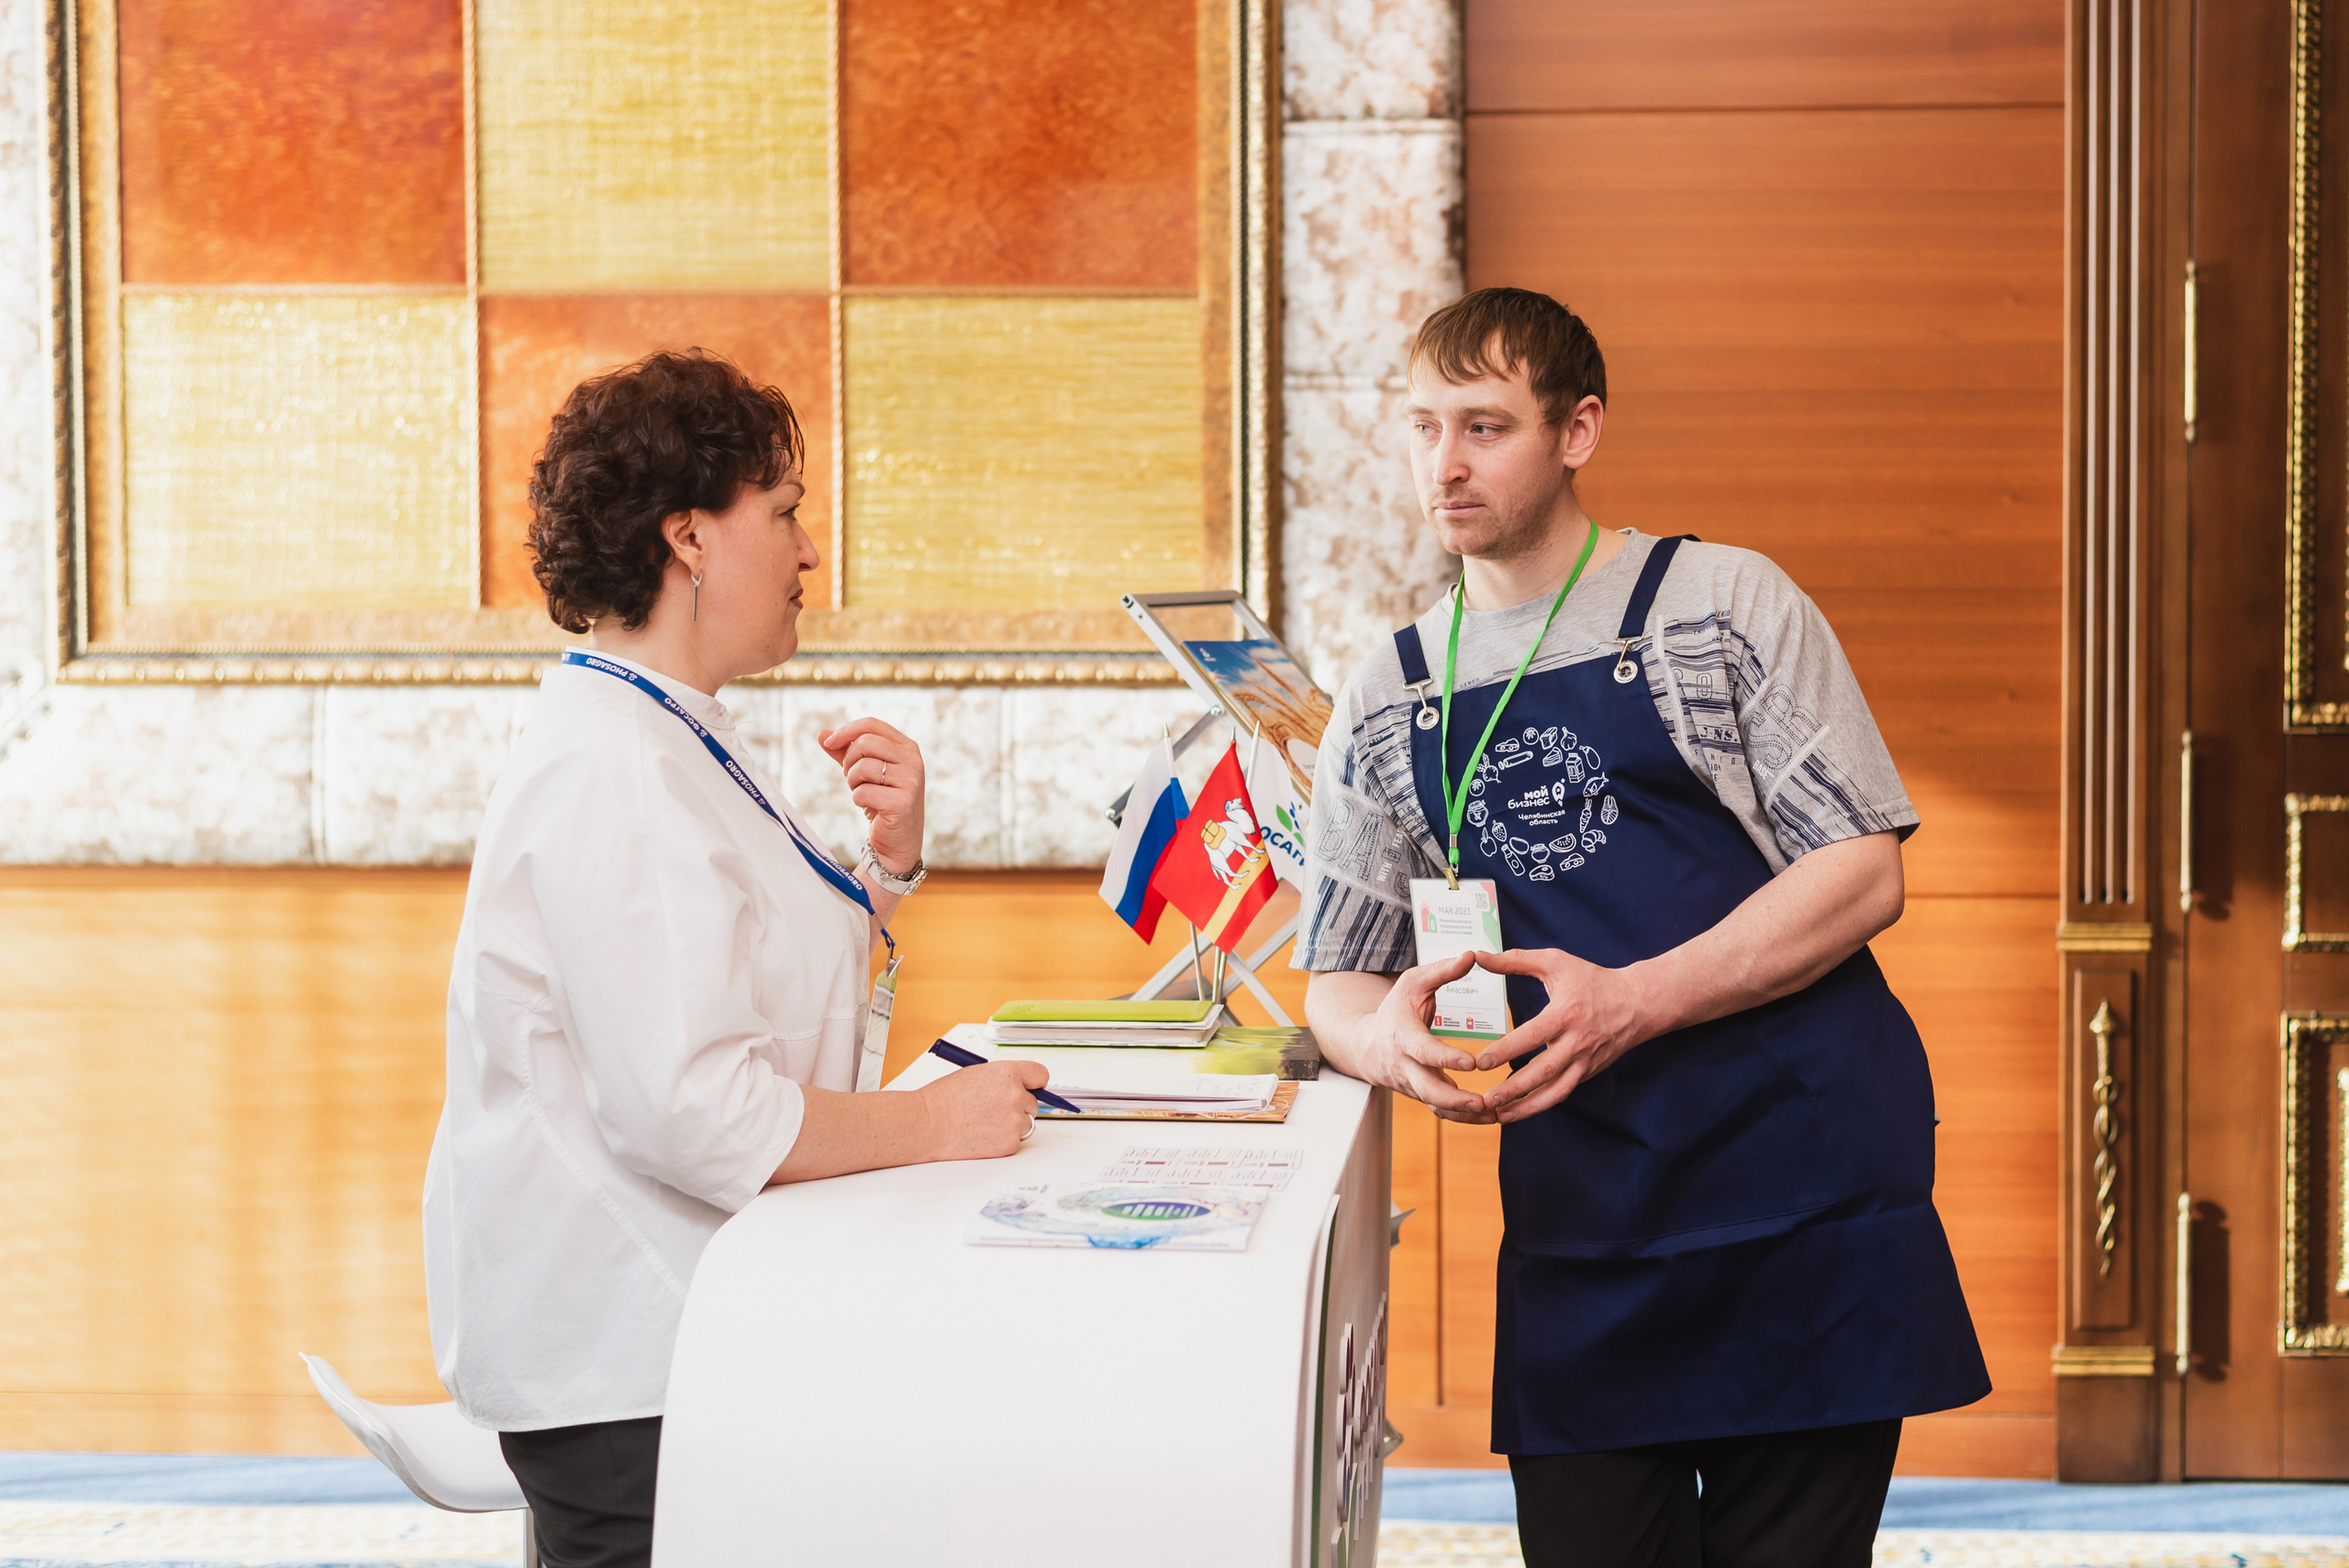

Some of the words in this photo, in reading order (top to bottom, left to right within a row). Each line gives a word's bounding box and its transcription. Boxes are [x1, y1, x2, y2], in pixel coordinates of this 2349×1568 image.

[585, 657, 629, 677] PHOSAGRO
[663, 697, 700, 731] ФОСАГРО
[725, 760, 760, 798] PHOSAGRO
[1508, 796, 1550, 809] бизнес
[1518, 809, 1566, 820] Челябинская
[1260, 826, 1305, 867] ОСАГ
[1376, 861, 1393, 882] WITH
[1438, 906, 1453, 915] МАК
[1454, 906, 1471, 916] 2023
